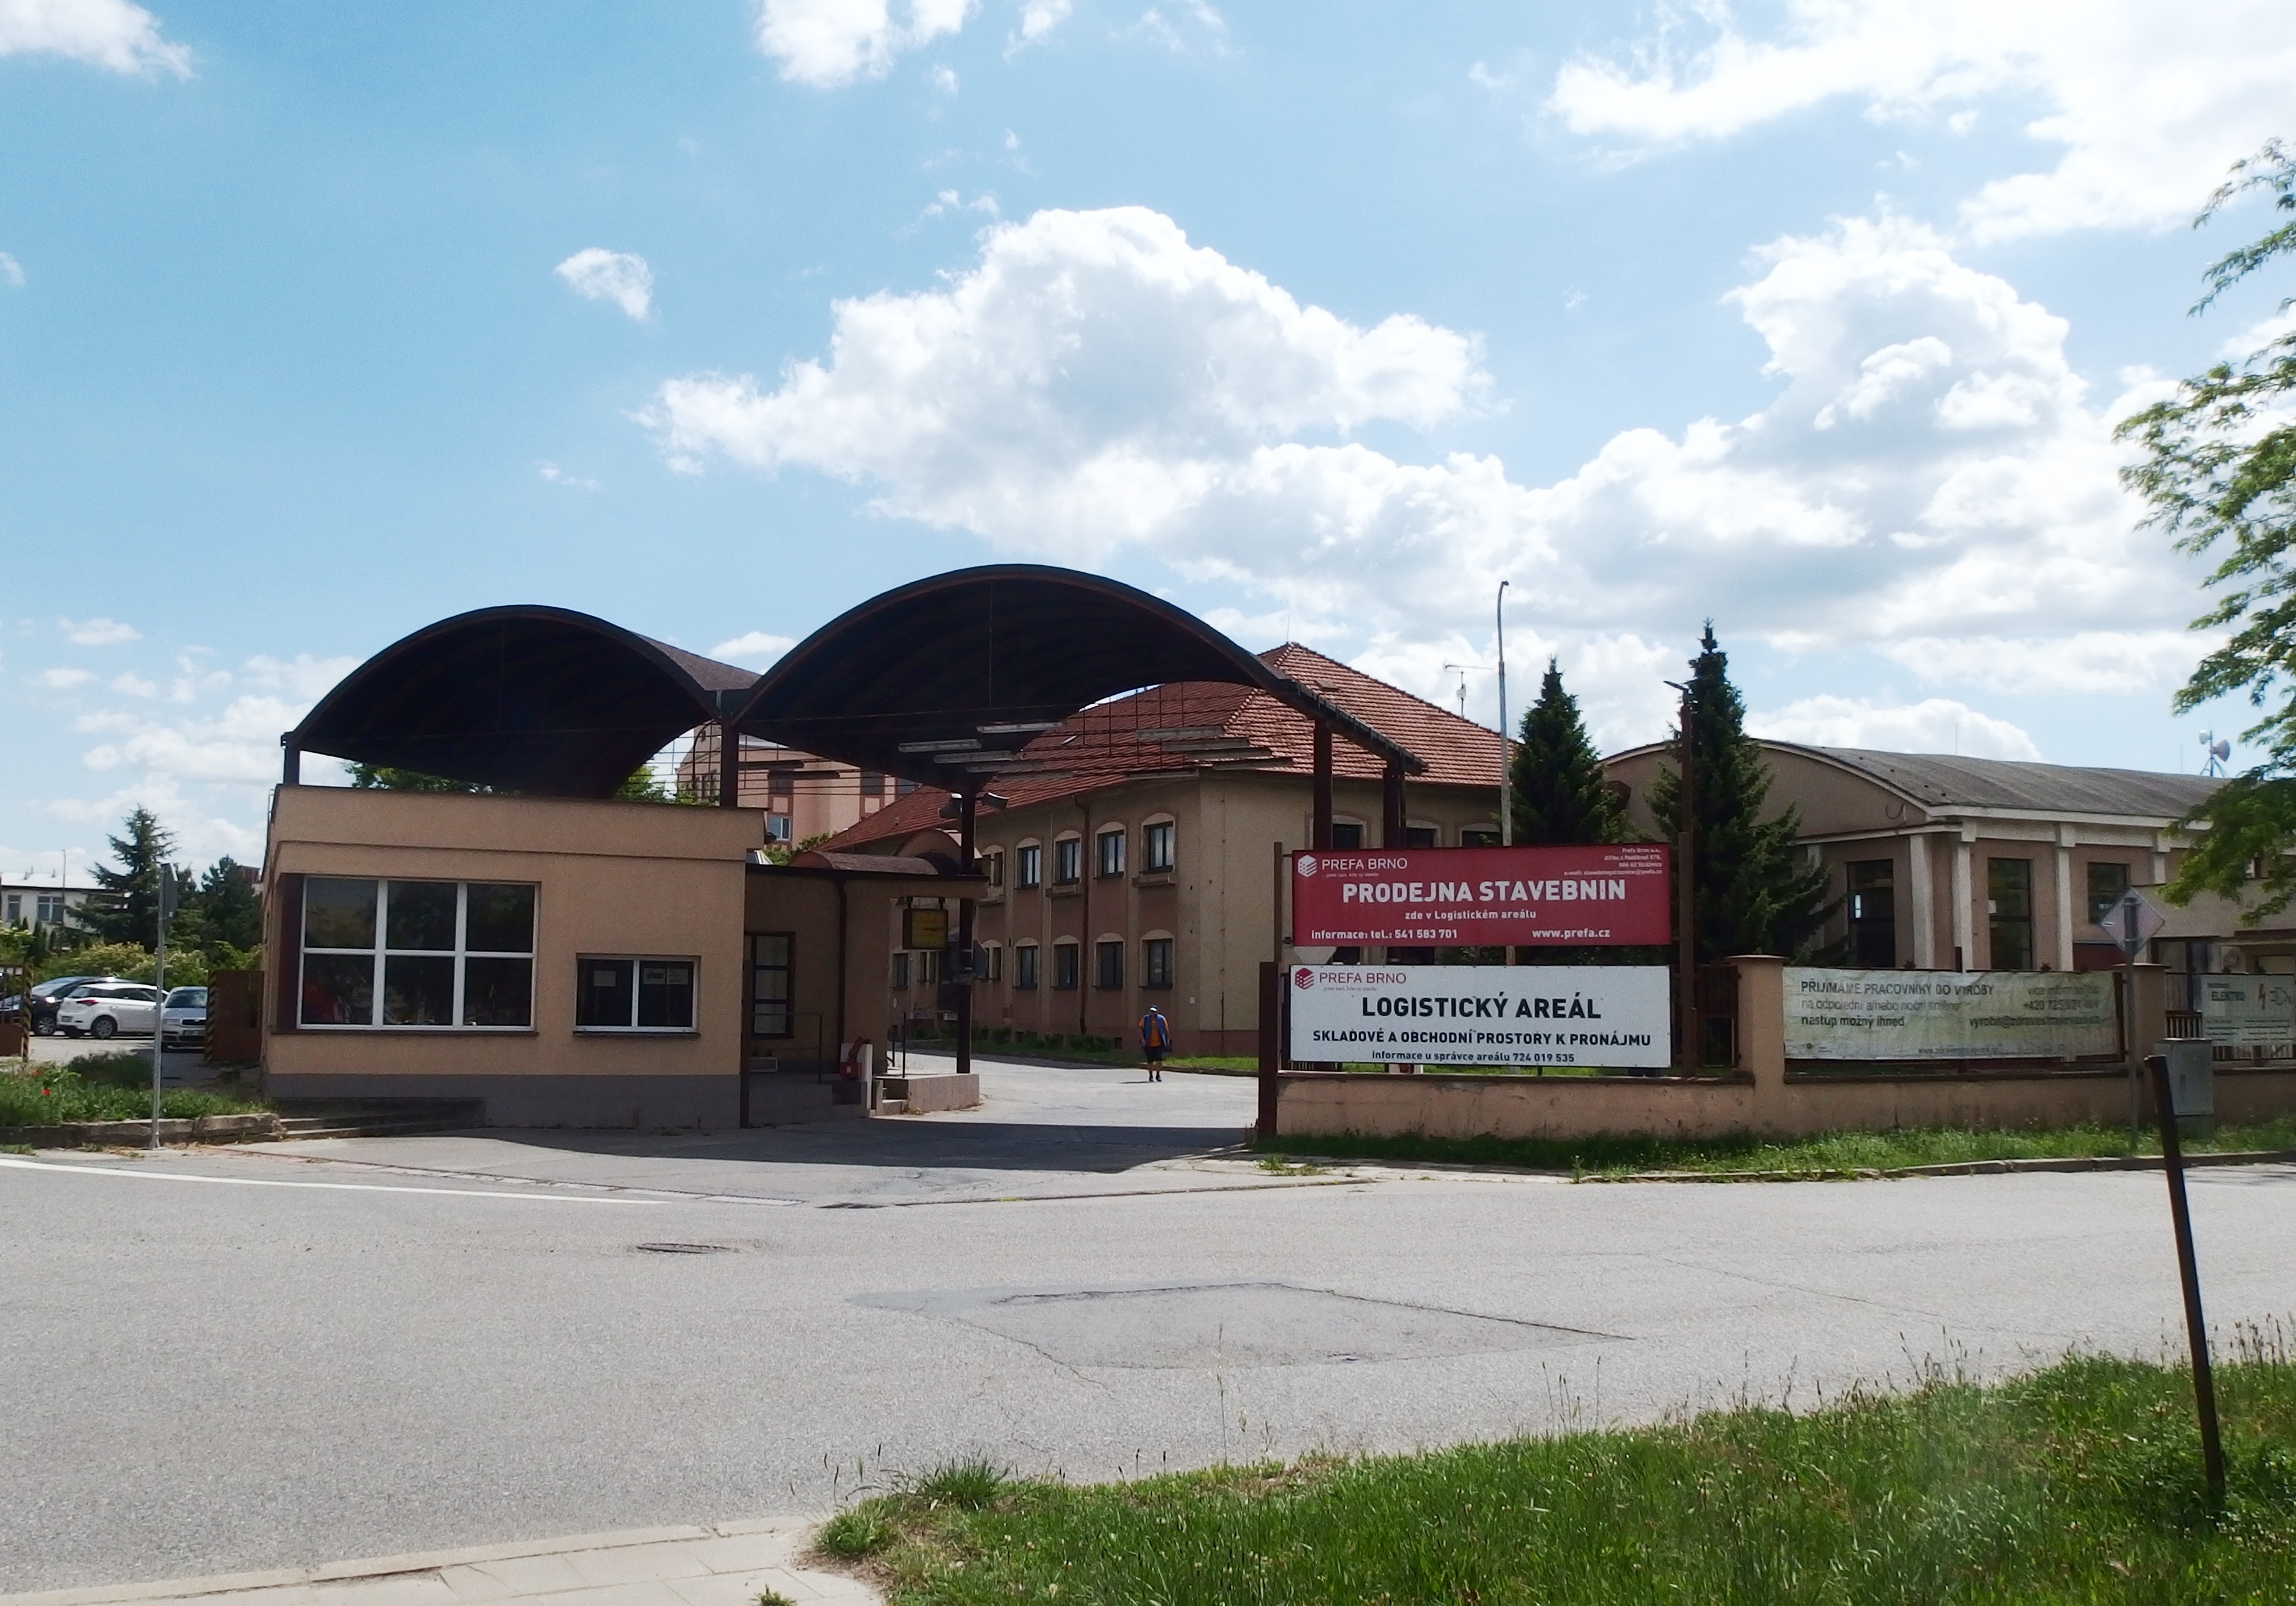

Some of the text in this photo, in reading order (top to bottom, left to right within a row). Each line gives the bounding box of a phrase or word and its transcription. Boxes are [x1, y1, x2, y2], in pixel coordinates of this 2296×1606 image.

[1321, 858, 1408, 870] PREFA BRNO
[1343, 879, 1625, 903] PRODEJNA STAVEBNIN
[1405, 911, 1423, 920] zde
[1435, 909, 1499, 920] Logistickém
[1501, 909, 1536, 919] areálu
[1311, 929, 1458, 939] informace: tel.: 541 583 701
[1531, 928, 1610, 939] www.prefa.cz
[1319, 973, 1407, 984] PREFA BRNO
[1936, 984, 1951, 994] DO
[1362, 991, 1601, 1019] LOGISTICKÝ AREÁL
[1876, 1014, 1905, 1026] ihned
[1313, 1028, 1651, 1046] SKLADOVÉ A OBCHODNÍ PROSTORY K PRONÁJMU
[1372, 1050, 1423, 1060] informace
[1434, 1052, 1474, 1062] správce
[1476, 1052, 1510, 1062] areálu
[1513, 1053, 1531, 1062] 724
[1534, 1053, 1553, 1062] 019
[1556, 1053, 1574, 1062] 535
